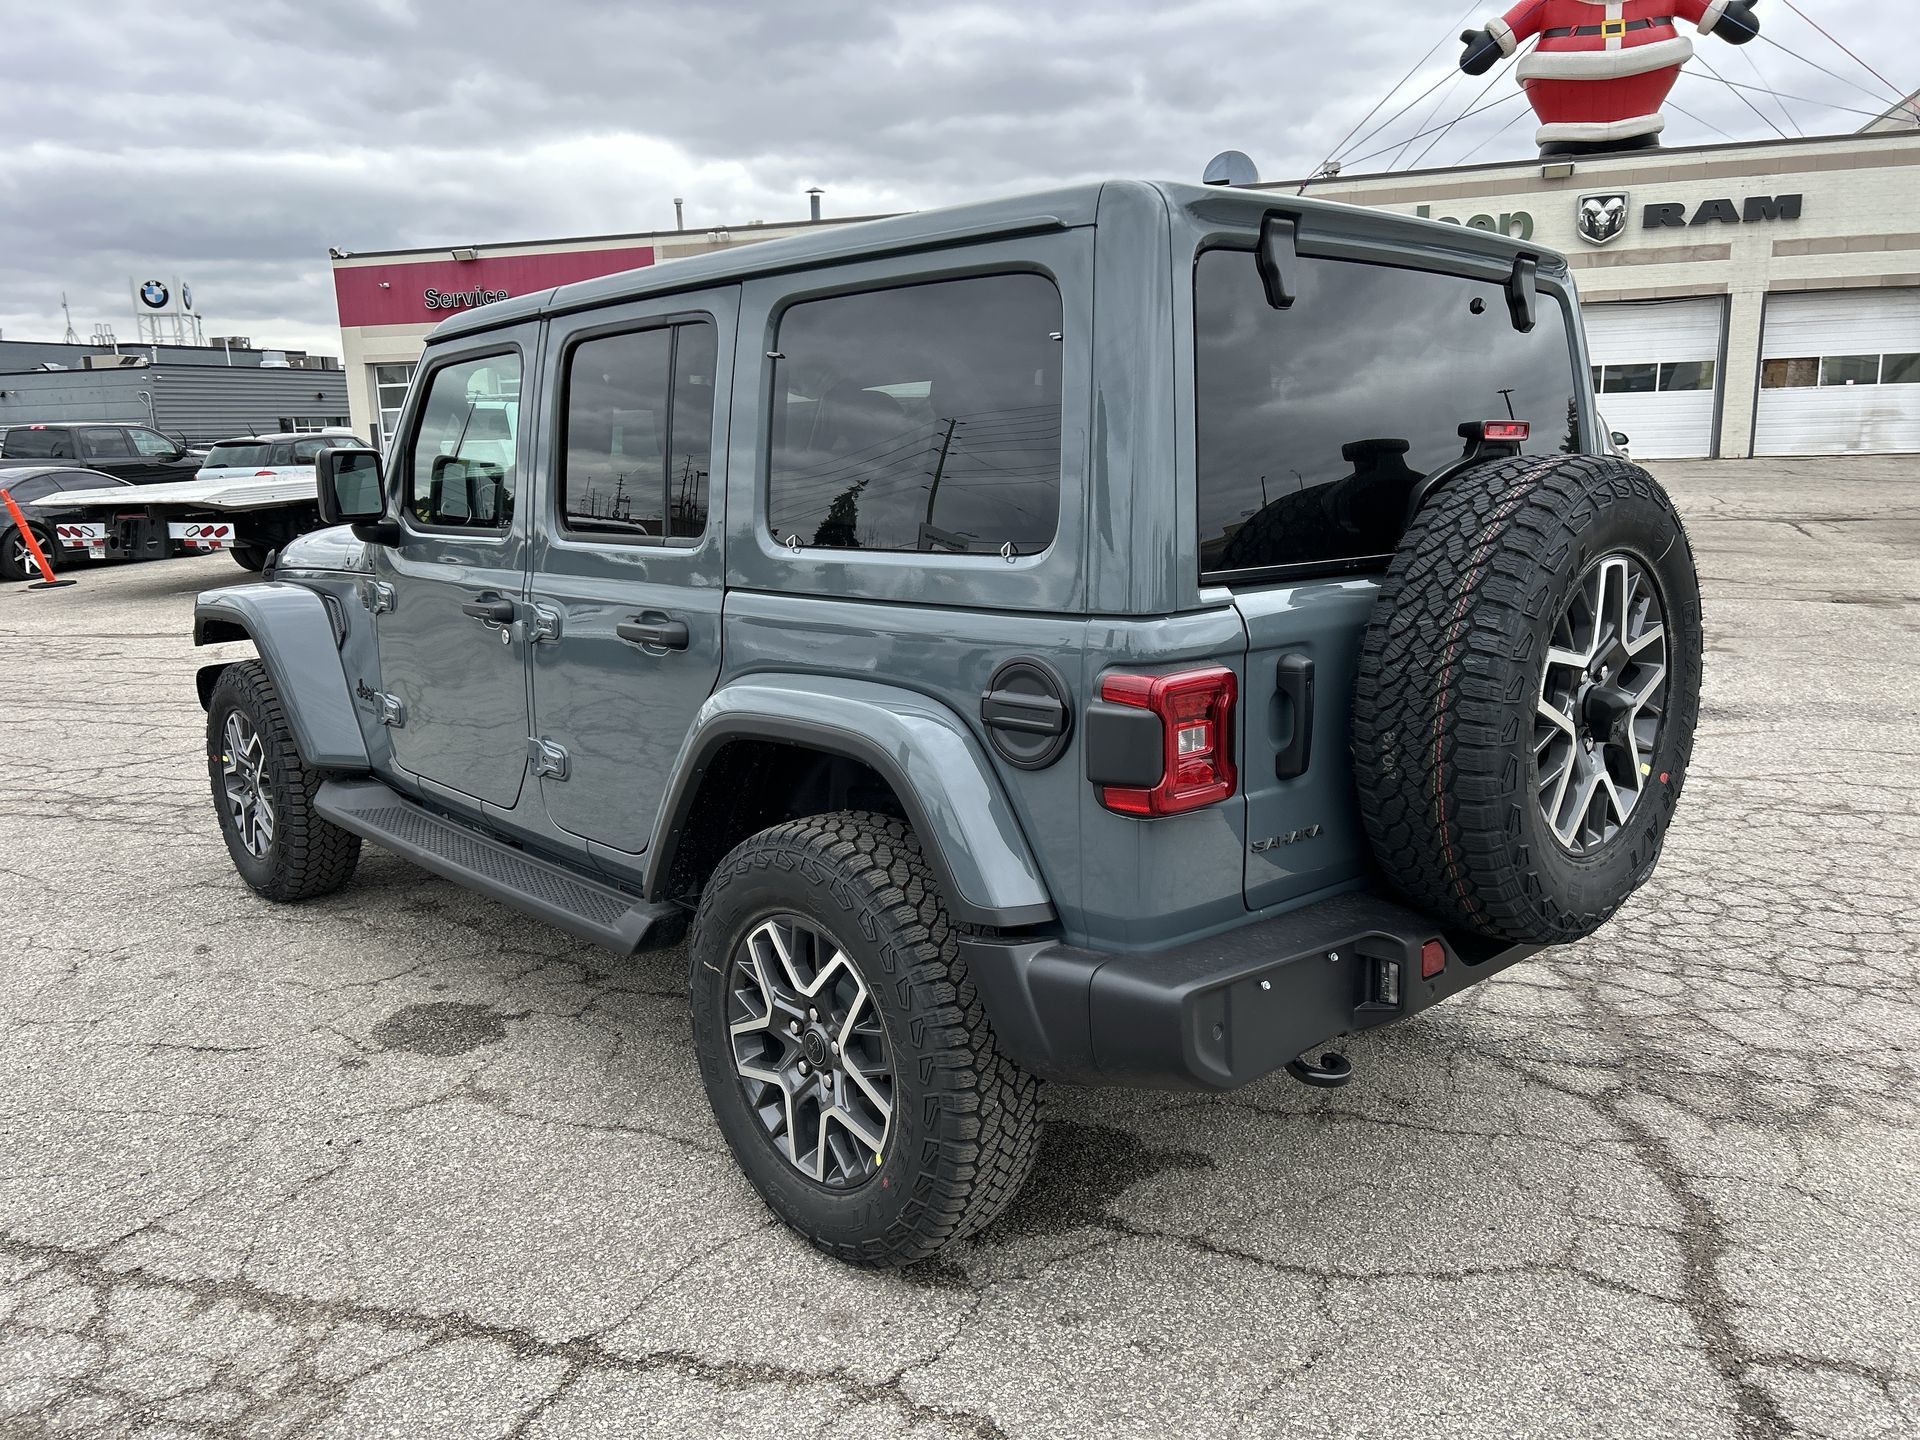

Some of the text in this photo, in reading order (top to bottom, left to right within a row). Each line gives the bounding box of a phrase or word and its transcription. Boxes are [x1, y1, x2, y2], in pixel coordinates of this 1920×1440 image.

[1416, 204, 1534, 242] ep
[1642, 193, 1803, 229] RAM
[424, 285, 509, 309] Service
[1251, 824, 1323, 854] SAHARA
